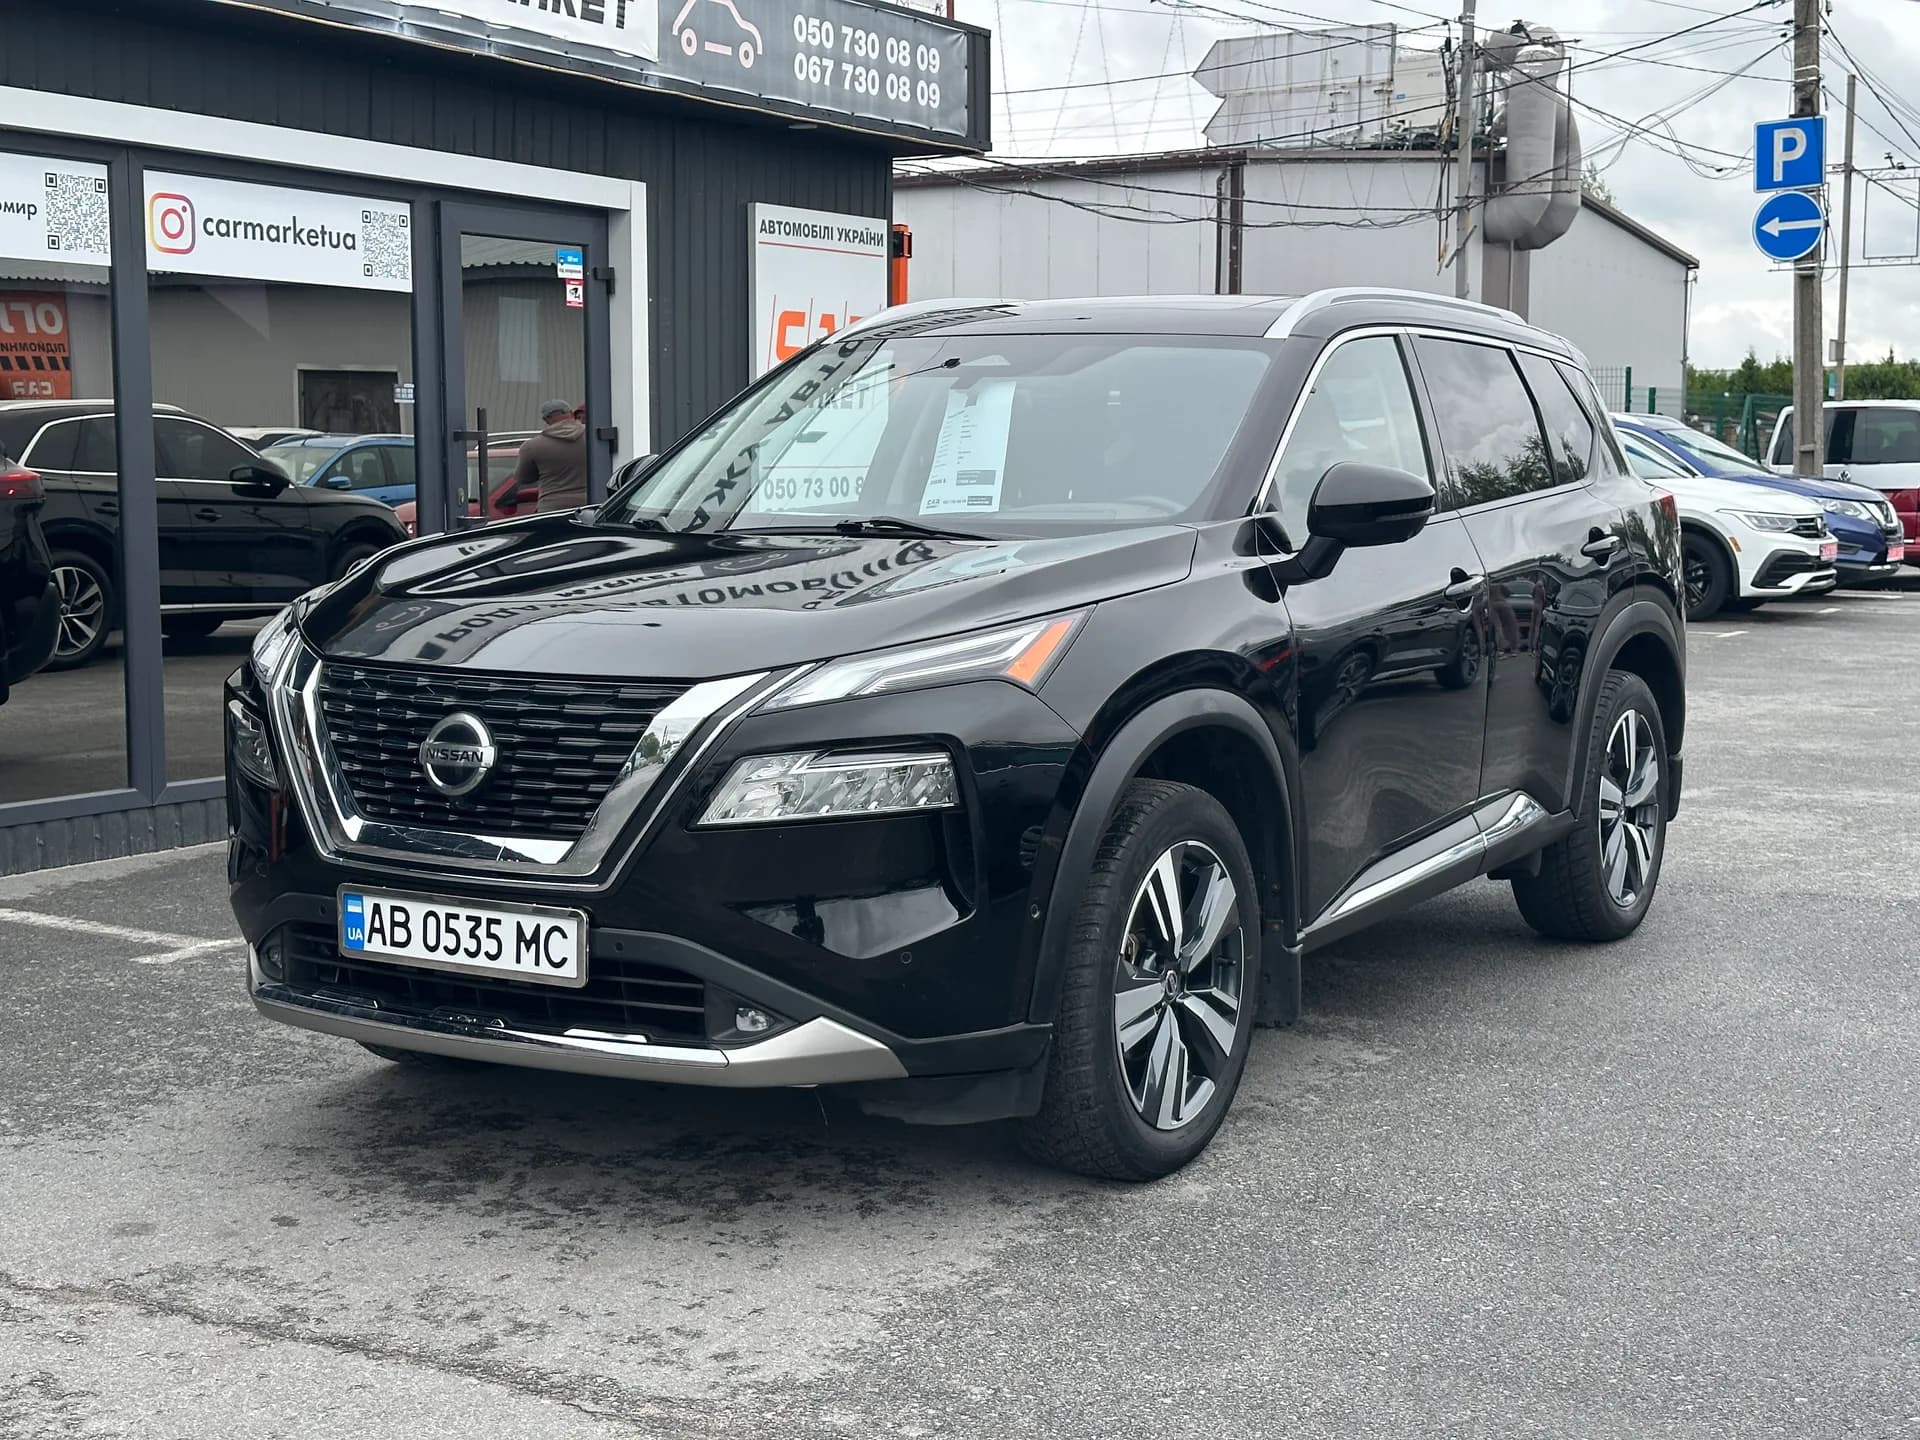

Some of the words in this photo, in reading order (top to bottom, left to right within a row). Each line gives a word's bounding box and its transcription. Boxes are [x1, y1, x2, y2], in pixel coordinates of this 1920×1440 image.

[793, 14, 834, 49] 050
[841, 25, 880, 60] 730
[885, 37, 911, 67] 08
[916, 44, 940, 74] 09
[794, 52, 834, 86] 067
[841, 62, 880, 96] 730
[885, 73, 911, 102] 08
[916, 80, 940, 109] 09
[1773, 127, 1807, 182] P
[202, 215, 357, 251] carmarketua
[759, 219, 834, 241] АВТОМОБІЛІ
[837, 226, 884, 247] УКРАЇНИ
[764, 478, 797, 500] 050
[804, 477, 824, 498] 73
[830, 476, 850, 498] 00
[427, 747, 484, 763] NISSAN
[348, 927, 364, 942] UA
[367, 902, 413, 949] AB
[422, 909, 504, 962] 0535
[515, 920, 570, 969] MC
